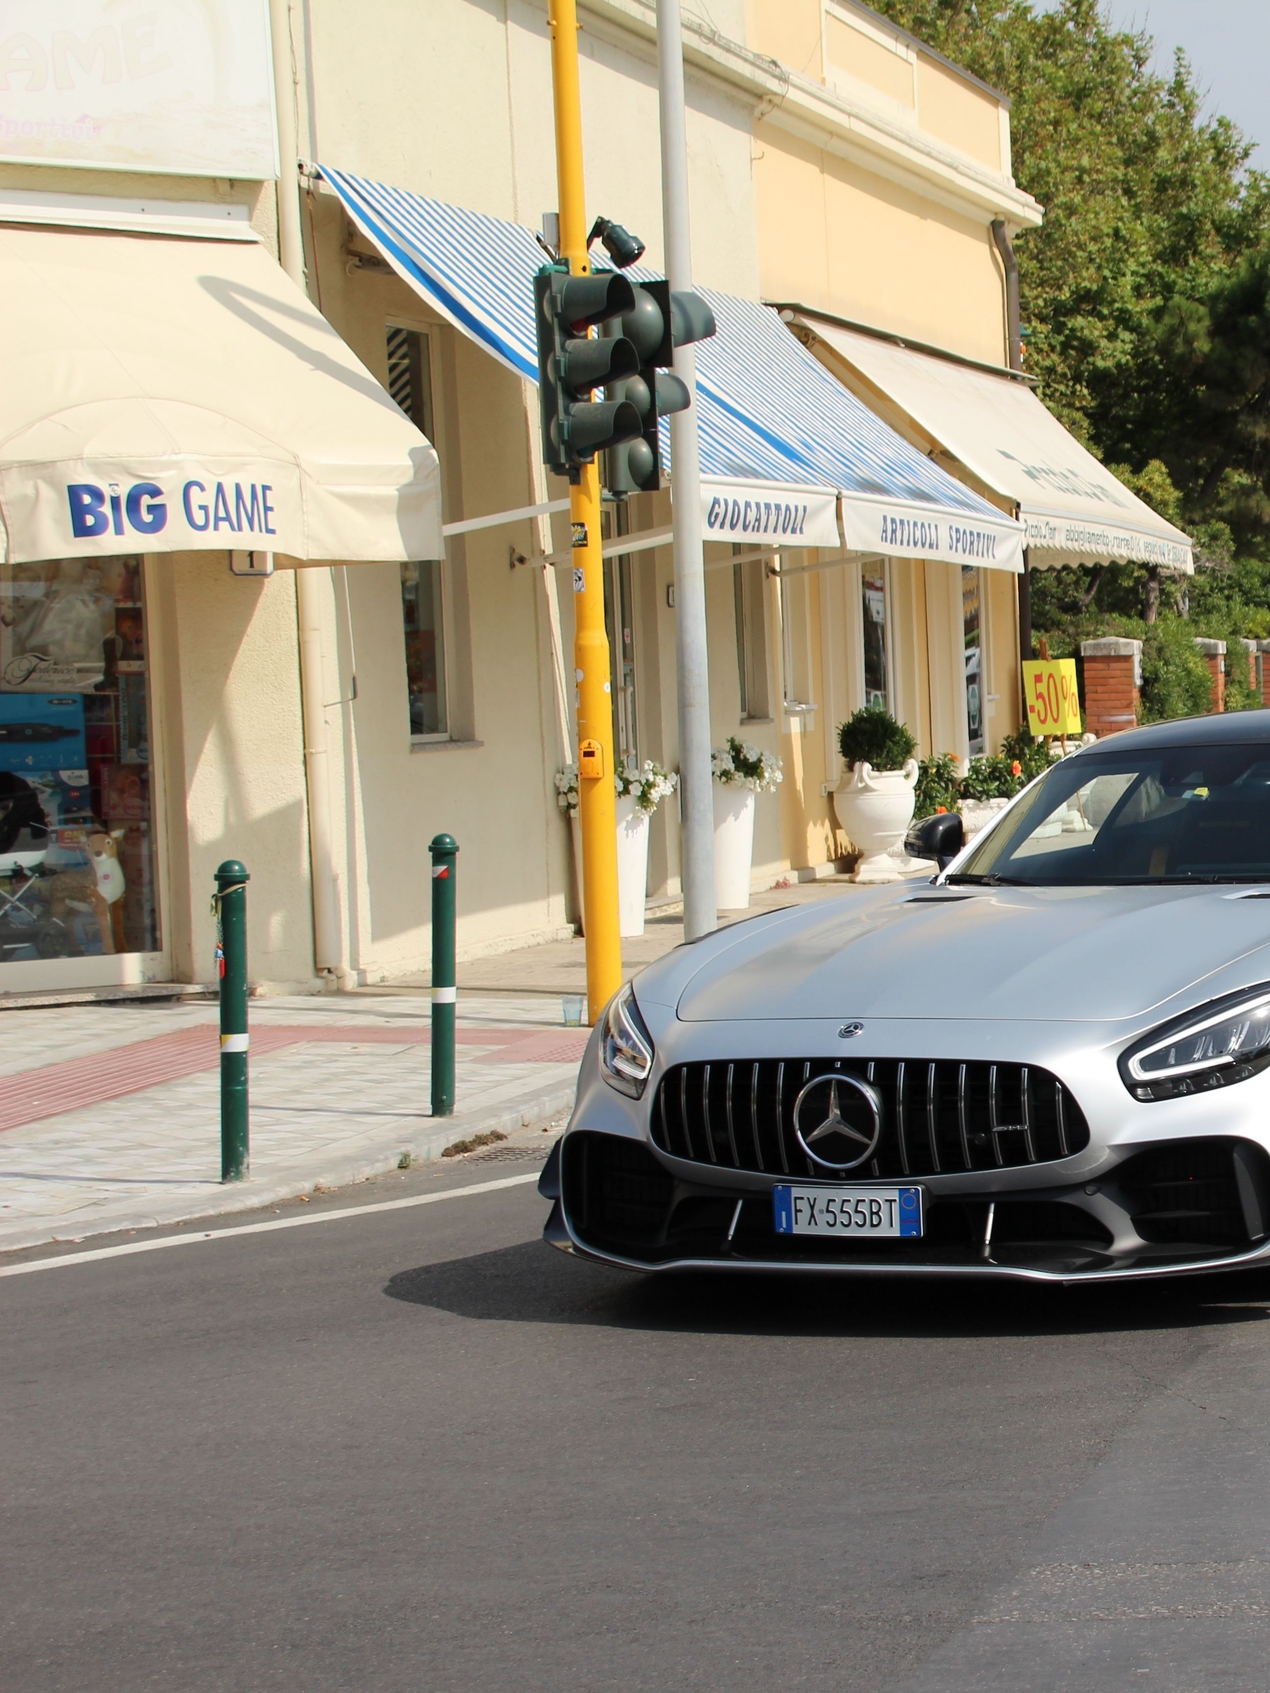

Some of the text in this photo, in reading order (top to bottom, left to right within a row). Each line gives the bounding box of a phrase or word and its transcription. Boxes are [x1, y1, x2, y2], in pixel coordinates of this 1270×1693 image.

[183, 480, 277, 535] GAME
[707, 496, 808, 535] GIOCATTOLI
[880, 514, 997, 559] ARTICOLI SPORTIVI
[793, 1196, 898, 1228] FX 555BT
